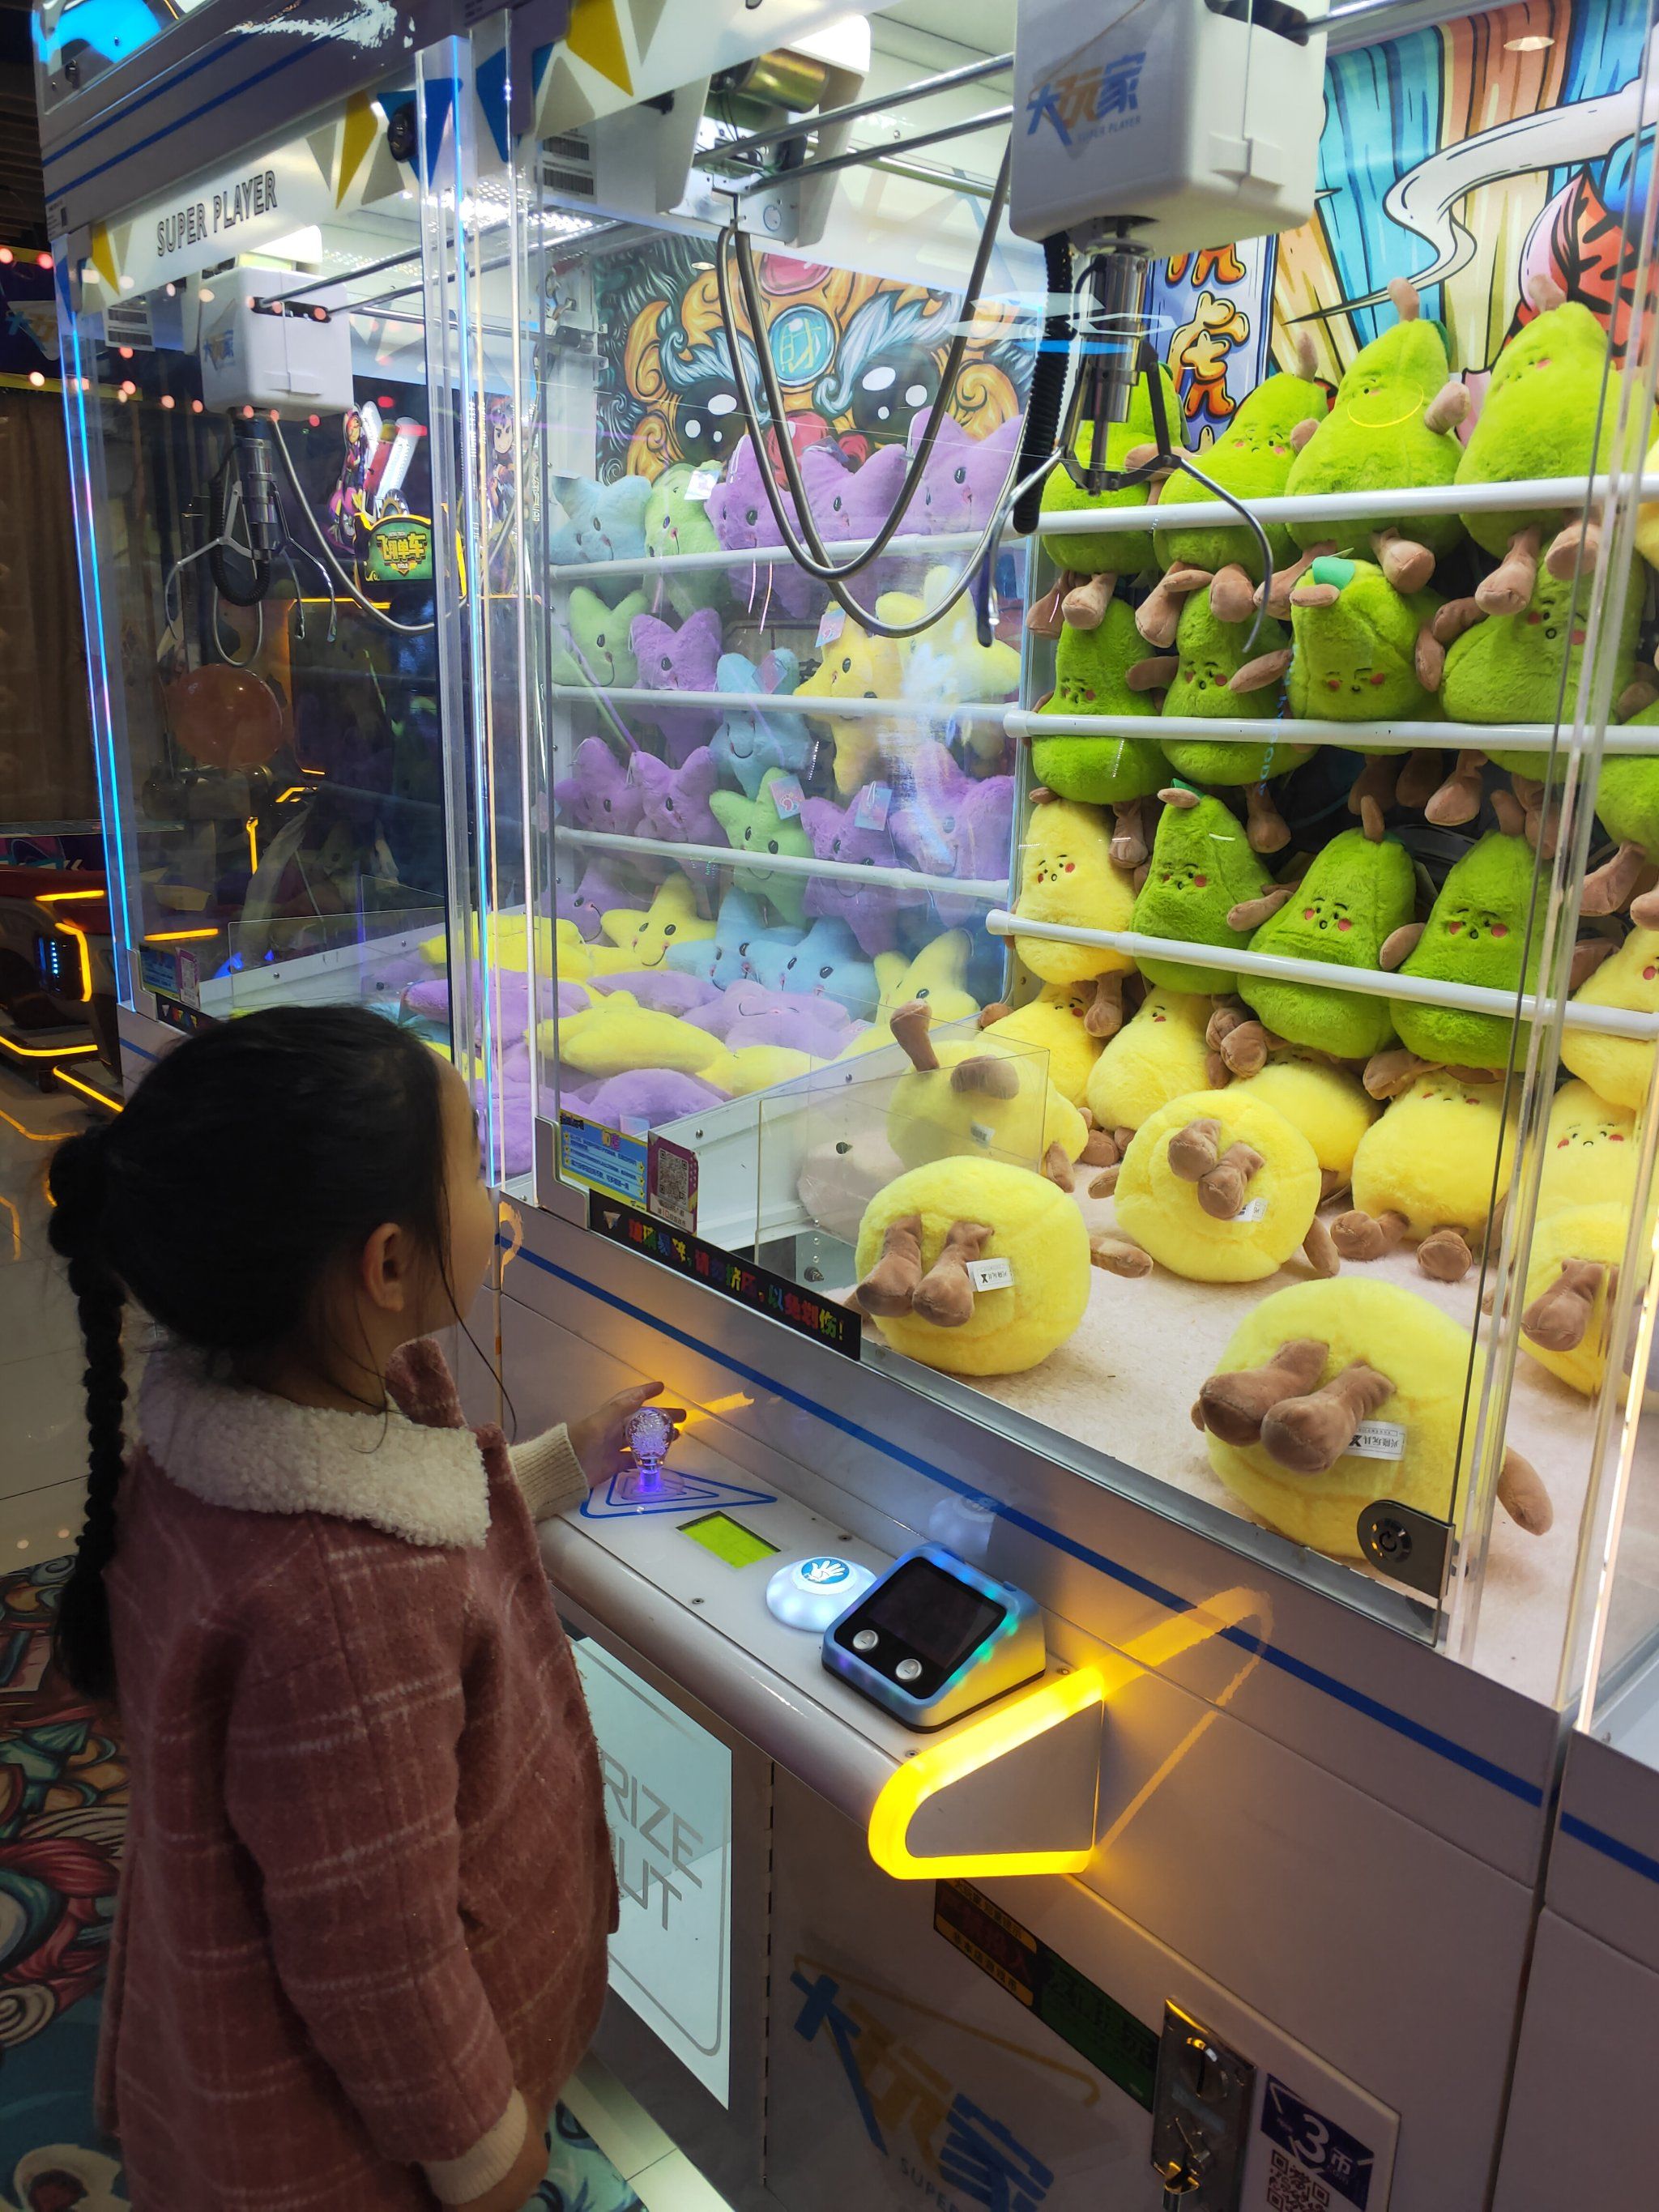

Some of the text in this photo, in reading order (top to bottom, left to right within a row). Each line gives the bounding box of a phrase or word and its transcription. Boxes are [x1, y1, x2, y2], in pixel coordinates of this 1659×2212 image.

[1026, 51, 1147, 146] 大玩家
[1109, 115, 1142, 134] PLAYER
[156, 170, 278, 258] SUPER PLAYER
[376, 532, 426, 561] 飞翔单车
[598, 1746, 704, 1890] RIZE
[613, 1831, 683, 1932] UT
[790, 1969, 1055, 2212] 大玩家
